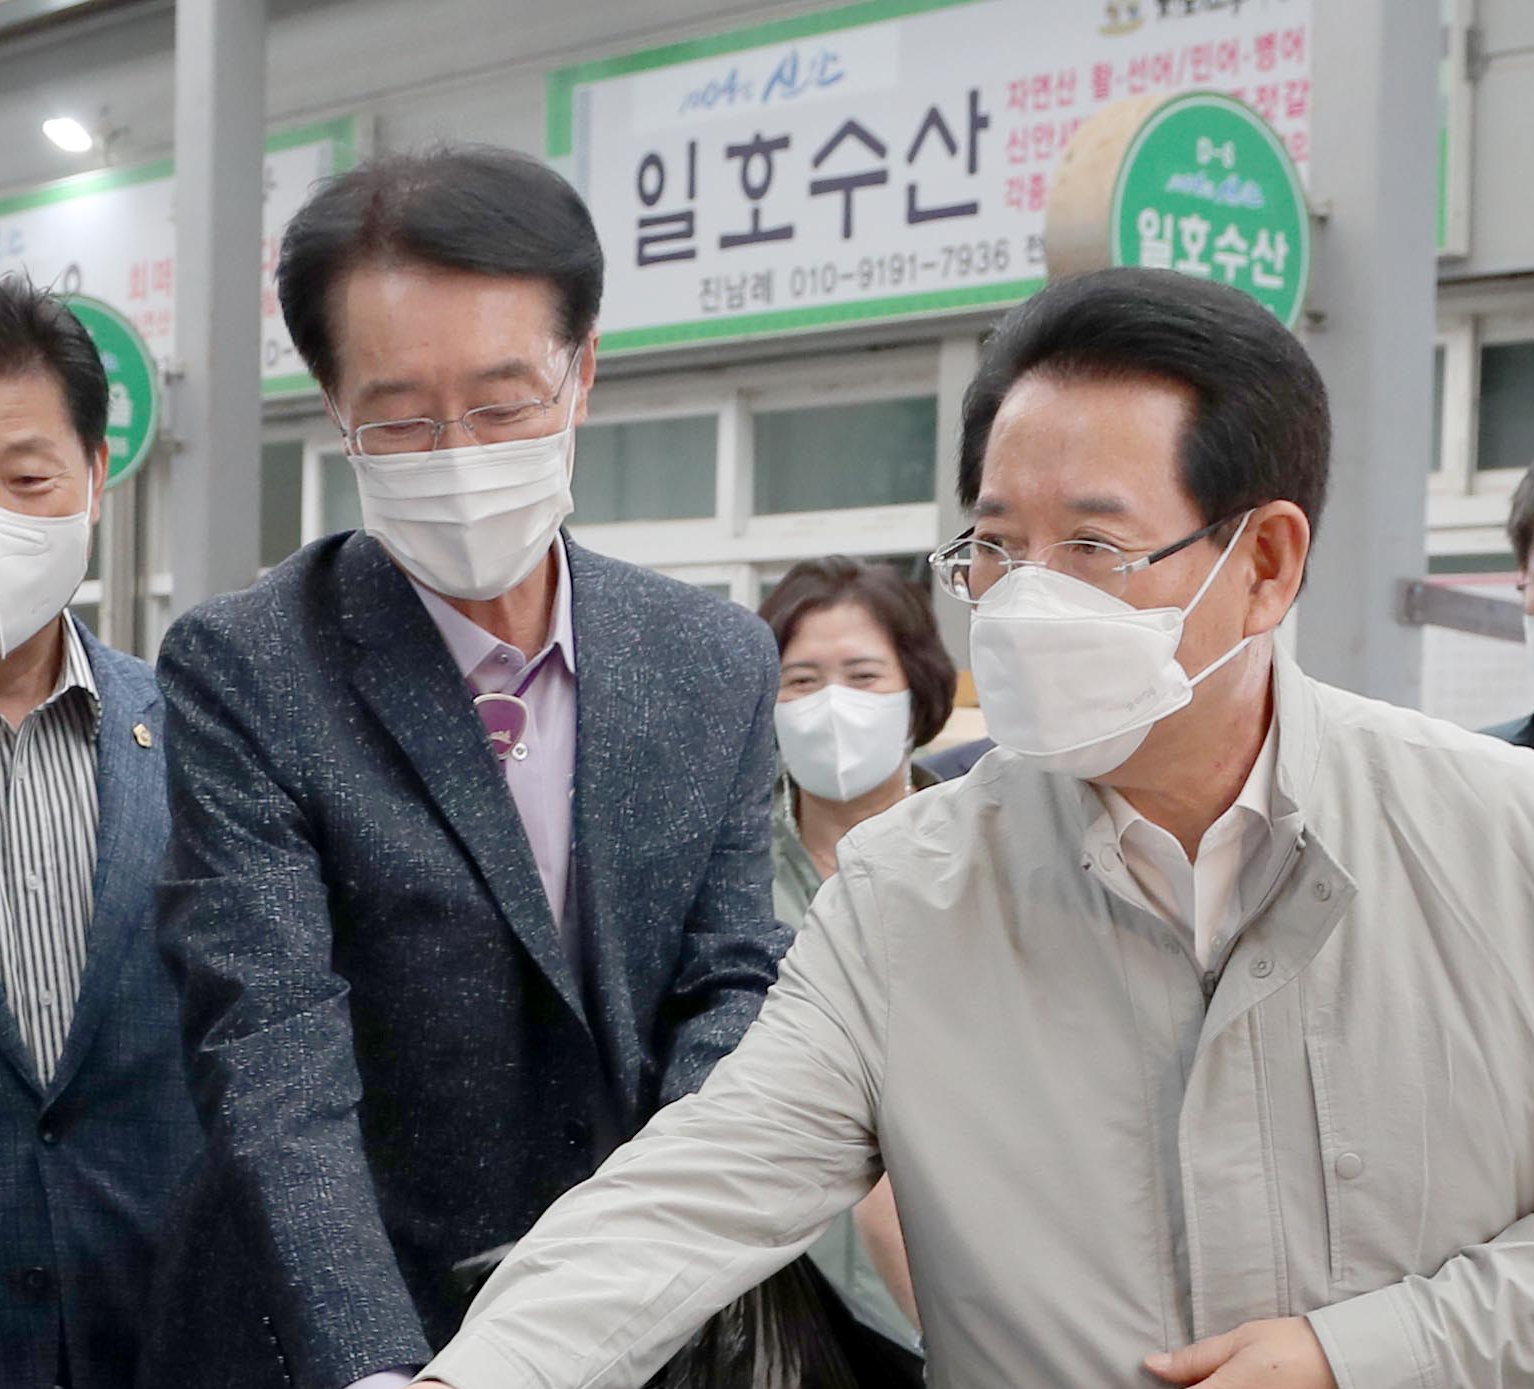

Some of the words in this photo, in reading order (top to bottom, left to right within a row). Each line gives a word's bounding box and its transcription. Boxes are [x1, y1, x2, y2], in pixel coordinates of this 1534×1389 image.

[1008, 70, 1077, 113] 자연산
[636, 88, 990, 267] 일호수산
[699, 269, 776, 312] 진남례
[790, 238, 1010, 297] 010-9191-7936
[1137, 207, 1289, 289] 일호수산
